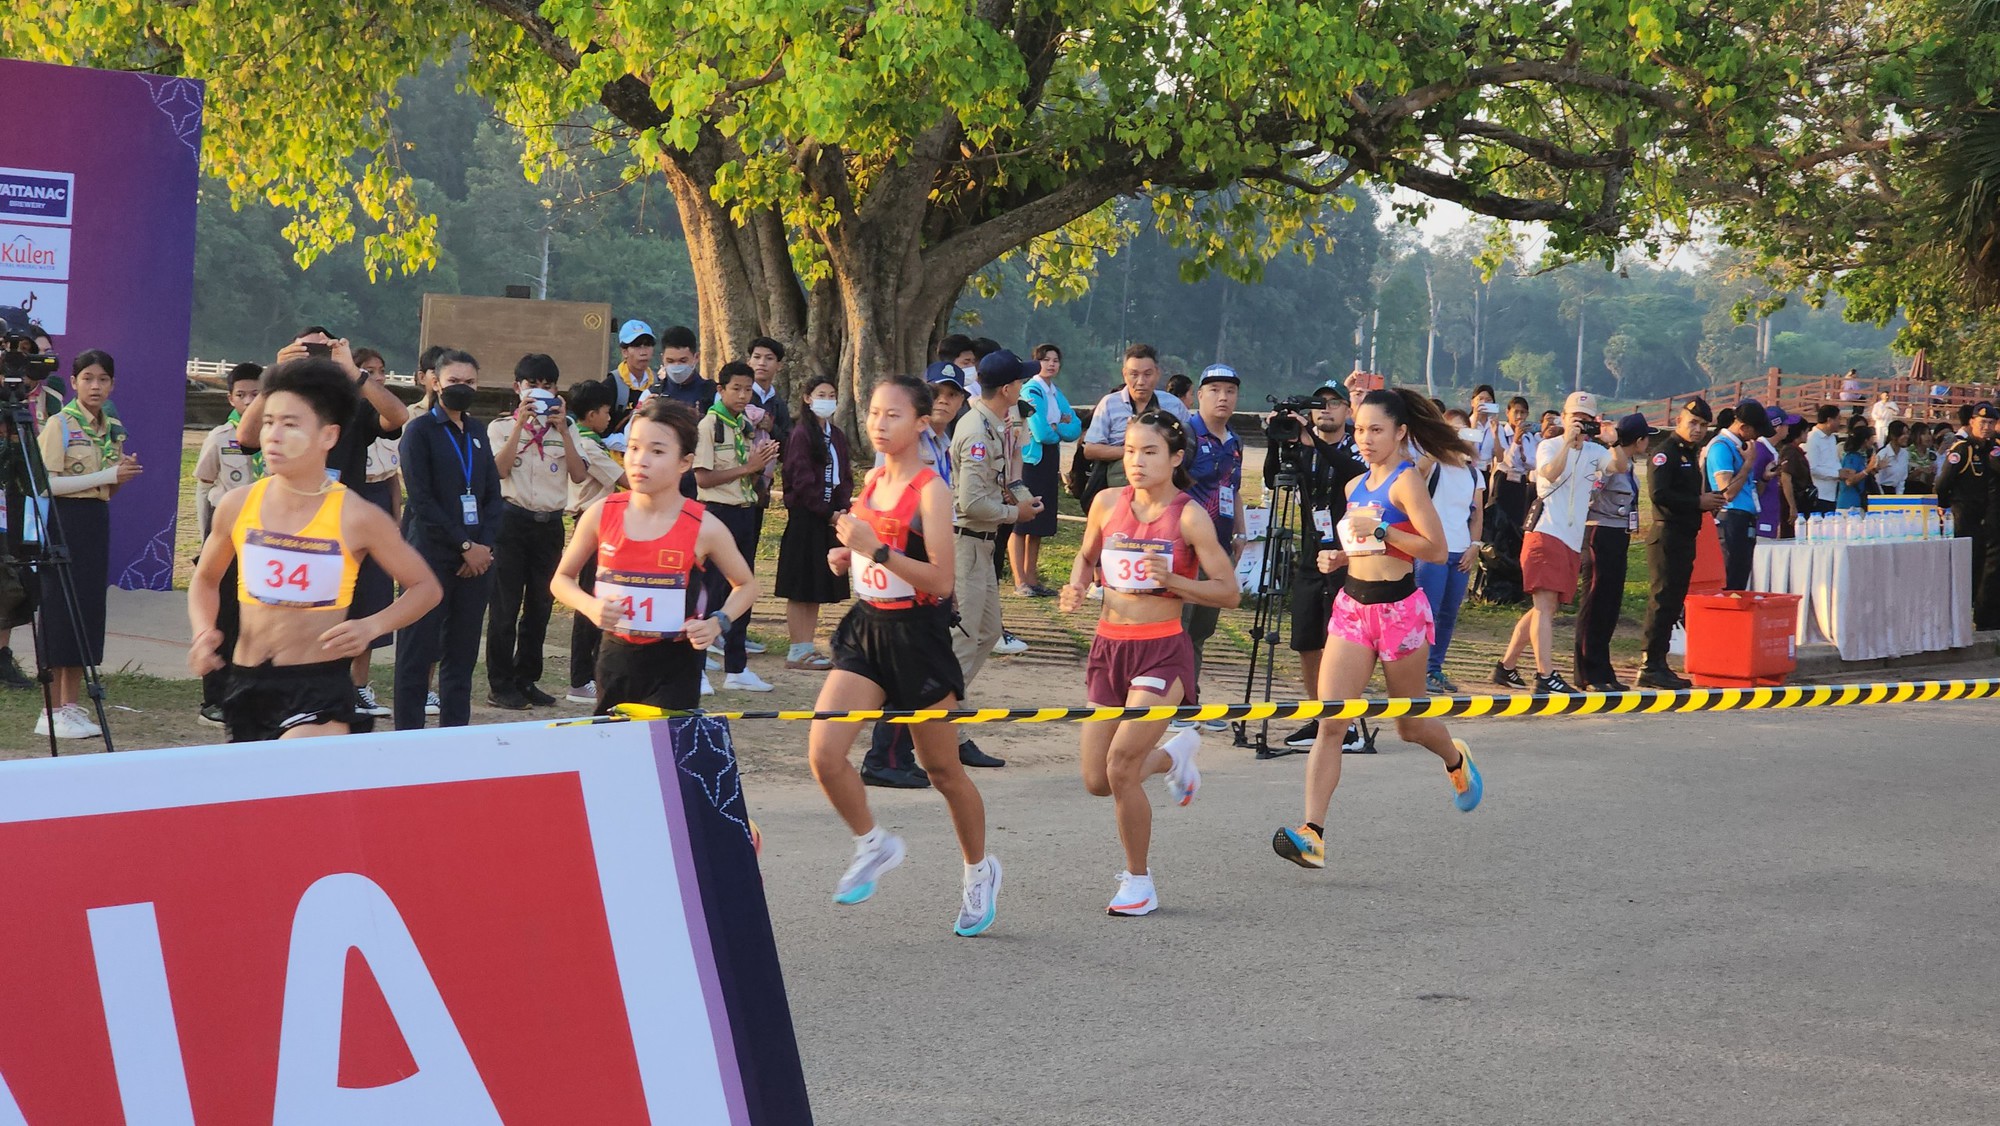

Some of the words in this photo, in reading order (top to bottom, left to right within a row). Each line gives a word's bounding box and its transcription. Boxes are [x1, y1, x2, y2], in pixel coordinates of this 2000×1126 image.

[1, 243, 55, 266] Kulen
[266, 560, 309, 591] 34
[862, 565, 887, 590] 40
[1118, 558, 1148, 582] 39
